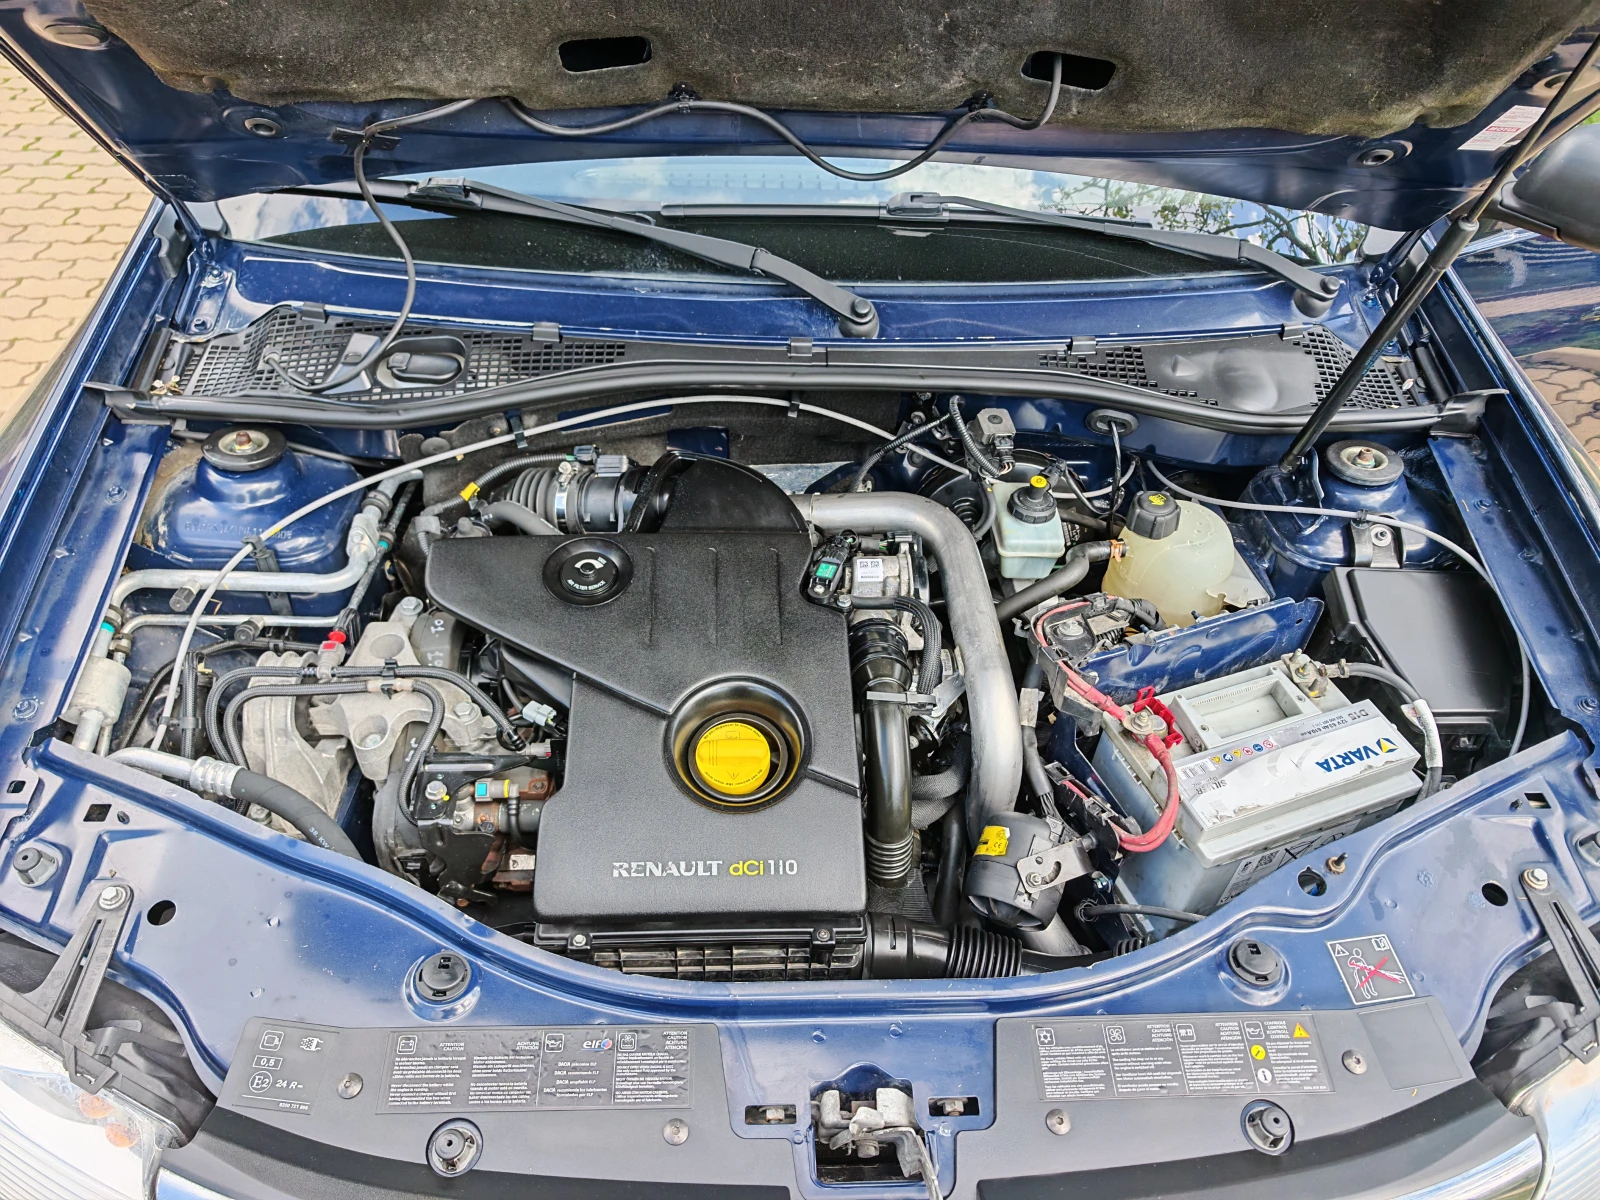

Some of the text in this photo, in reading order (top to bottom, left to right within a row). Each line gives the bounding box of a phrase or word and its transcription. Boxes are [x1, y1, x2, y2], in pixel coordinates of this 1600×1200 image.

[1315, 746, 1380, 772] VARTA
[612, 859, 798, 877] RENAULT dCi 110
[583, 1040, 601, 1049] elf
[260, 1058, 275, 1066] 0,5
[252, 1076, 269, 1088] E2
[276, 1080, 287, 1088] 24
